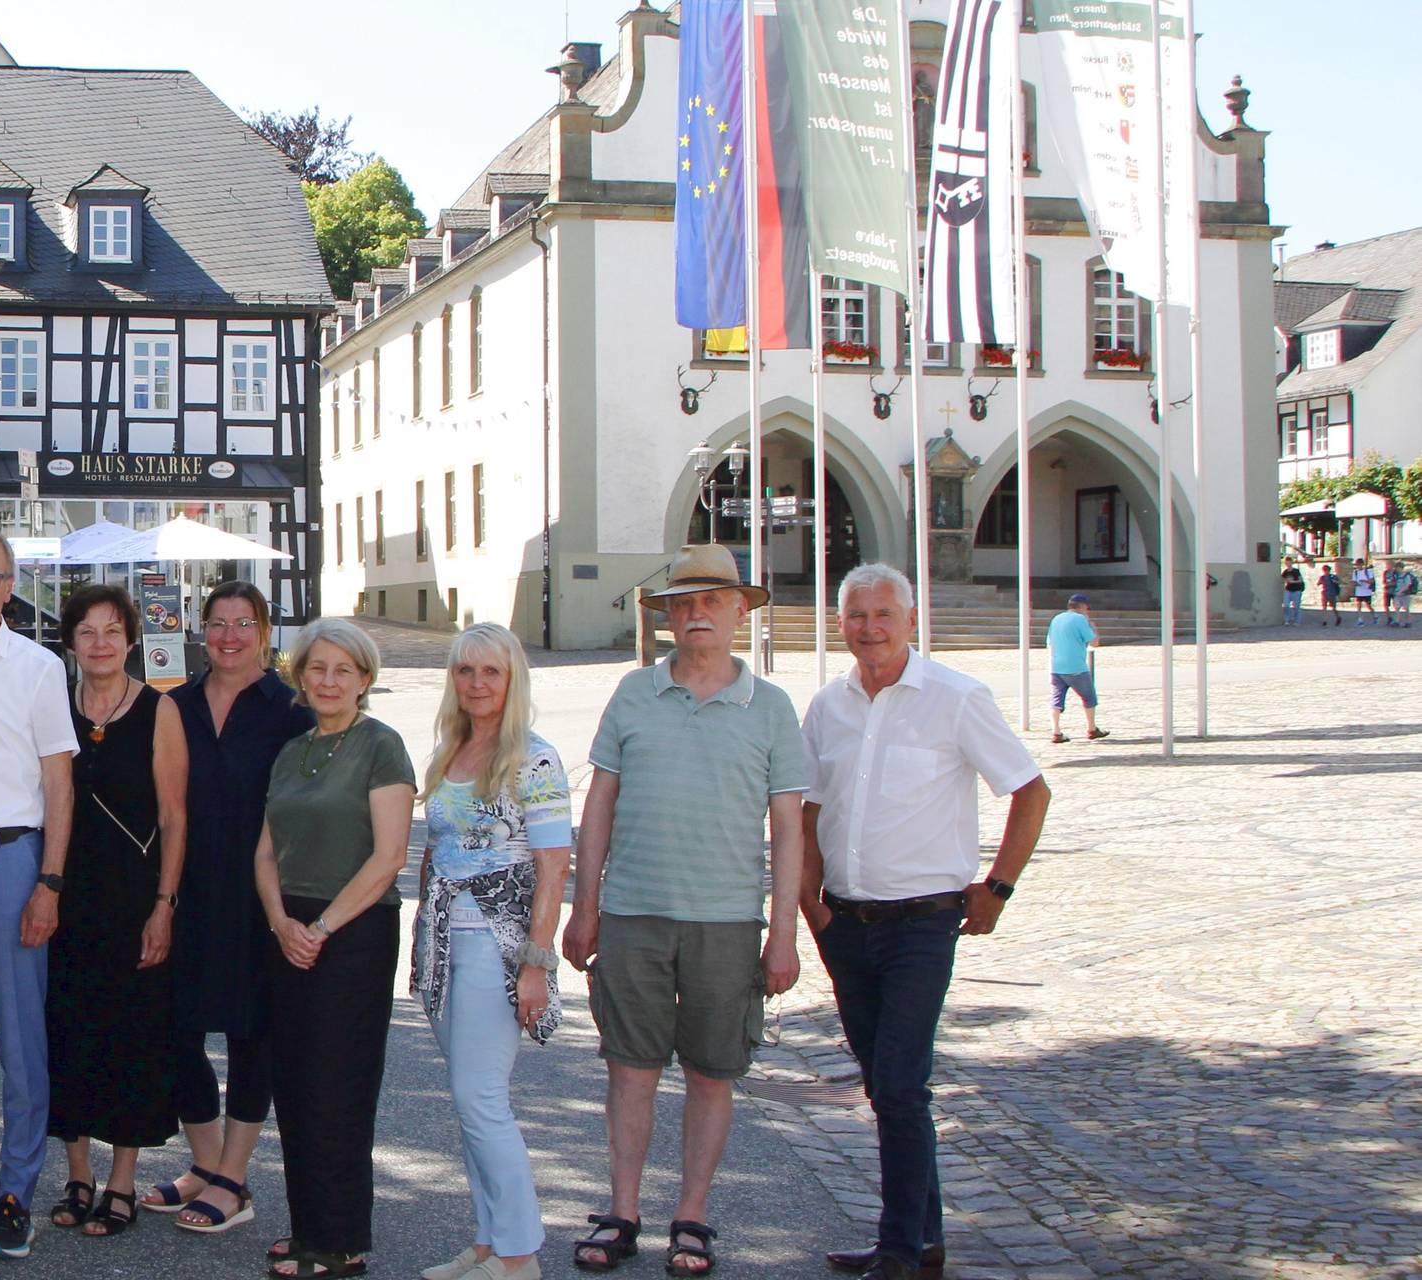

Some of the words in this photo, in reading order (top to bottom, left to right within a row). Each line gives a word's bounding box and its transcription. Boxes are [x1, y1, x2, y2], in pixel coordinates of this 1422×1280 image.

[81, 455, 126, 473] HAUS
[135, 456, 203, 475] STARKE
[120, 474, 172, 483] RESTAURANT
